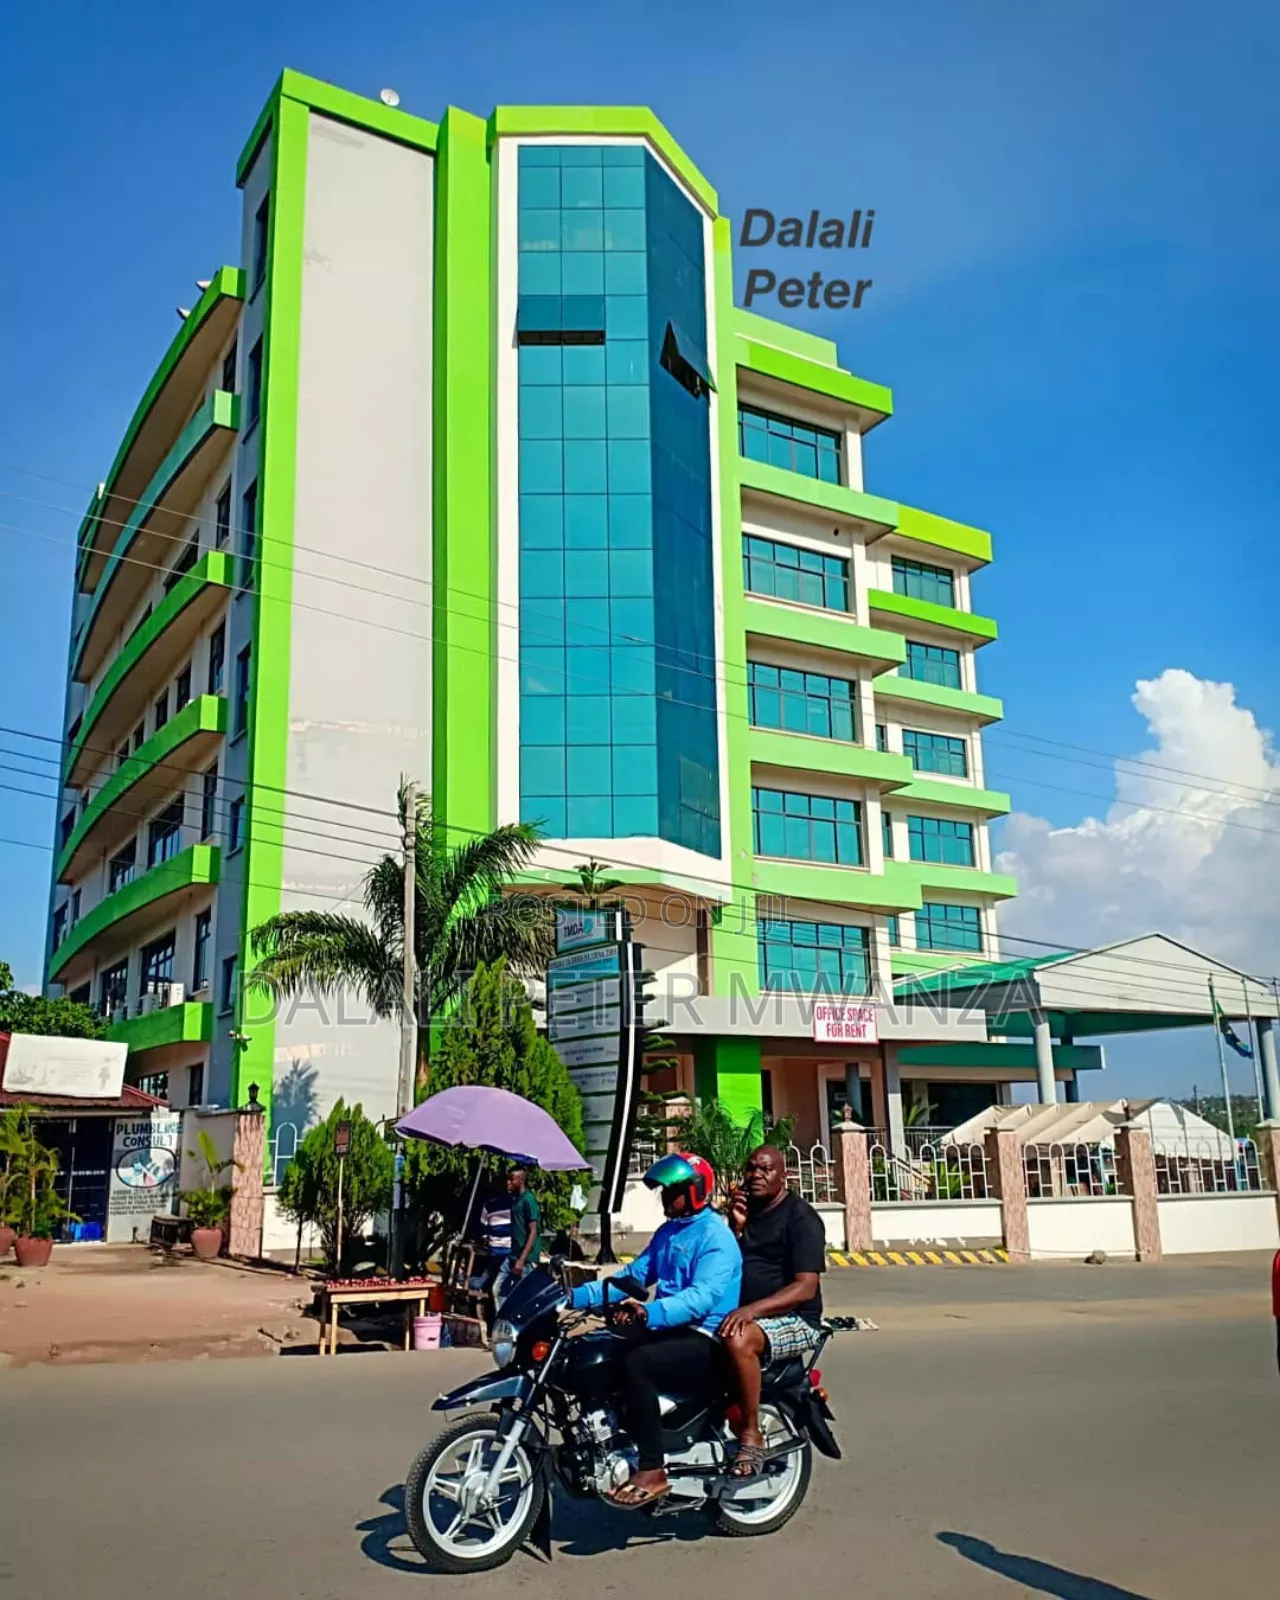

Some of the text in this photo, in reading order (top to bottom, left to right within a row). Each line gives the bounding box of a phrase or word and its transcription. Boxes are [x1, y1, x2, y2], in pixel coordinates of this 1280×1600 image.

[816, 1006, 873, 1022] OFFICE SPACE
[826, 1023, 867, 1038] FOR RENT
[115, 1122, 183, 1135] PLUMBLINE
